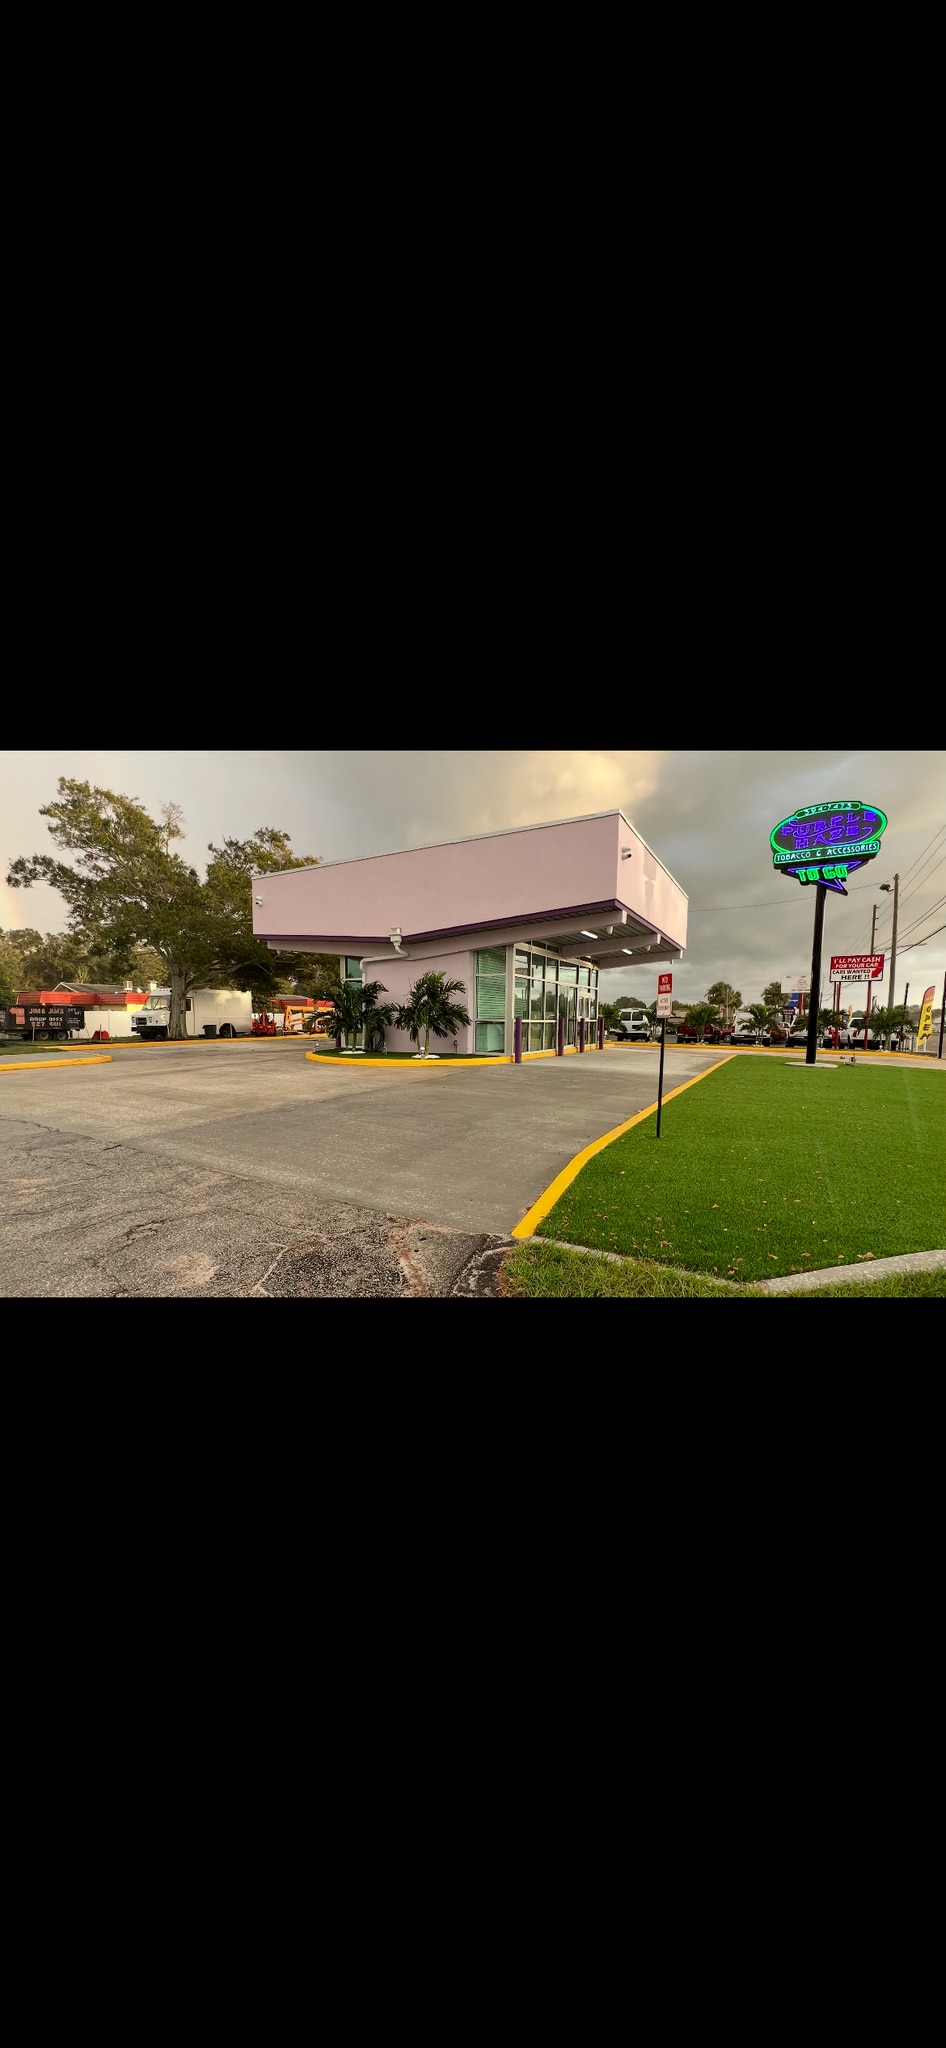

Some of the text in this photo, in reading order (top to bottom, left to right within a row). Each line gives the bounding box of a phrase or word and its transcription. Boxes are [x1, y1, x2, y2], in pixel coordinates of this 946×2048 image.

[781, 810, 876, 836] PURPLE
[794, 826, 859, 849] HAZE
[776, 852, 811, 861] TOBACCO
[826, 843, 877, 855] ACCESSORIES
[796, 865, 848, 881] TO GO
[661, 976, 669, 984] NO
[920, 1005, 932, 1040] OPEN
